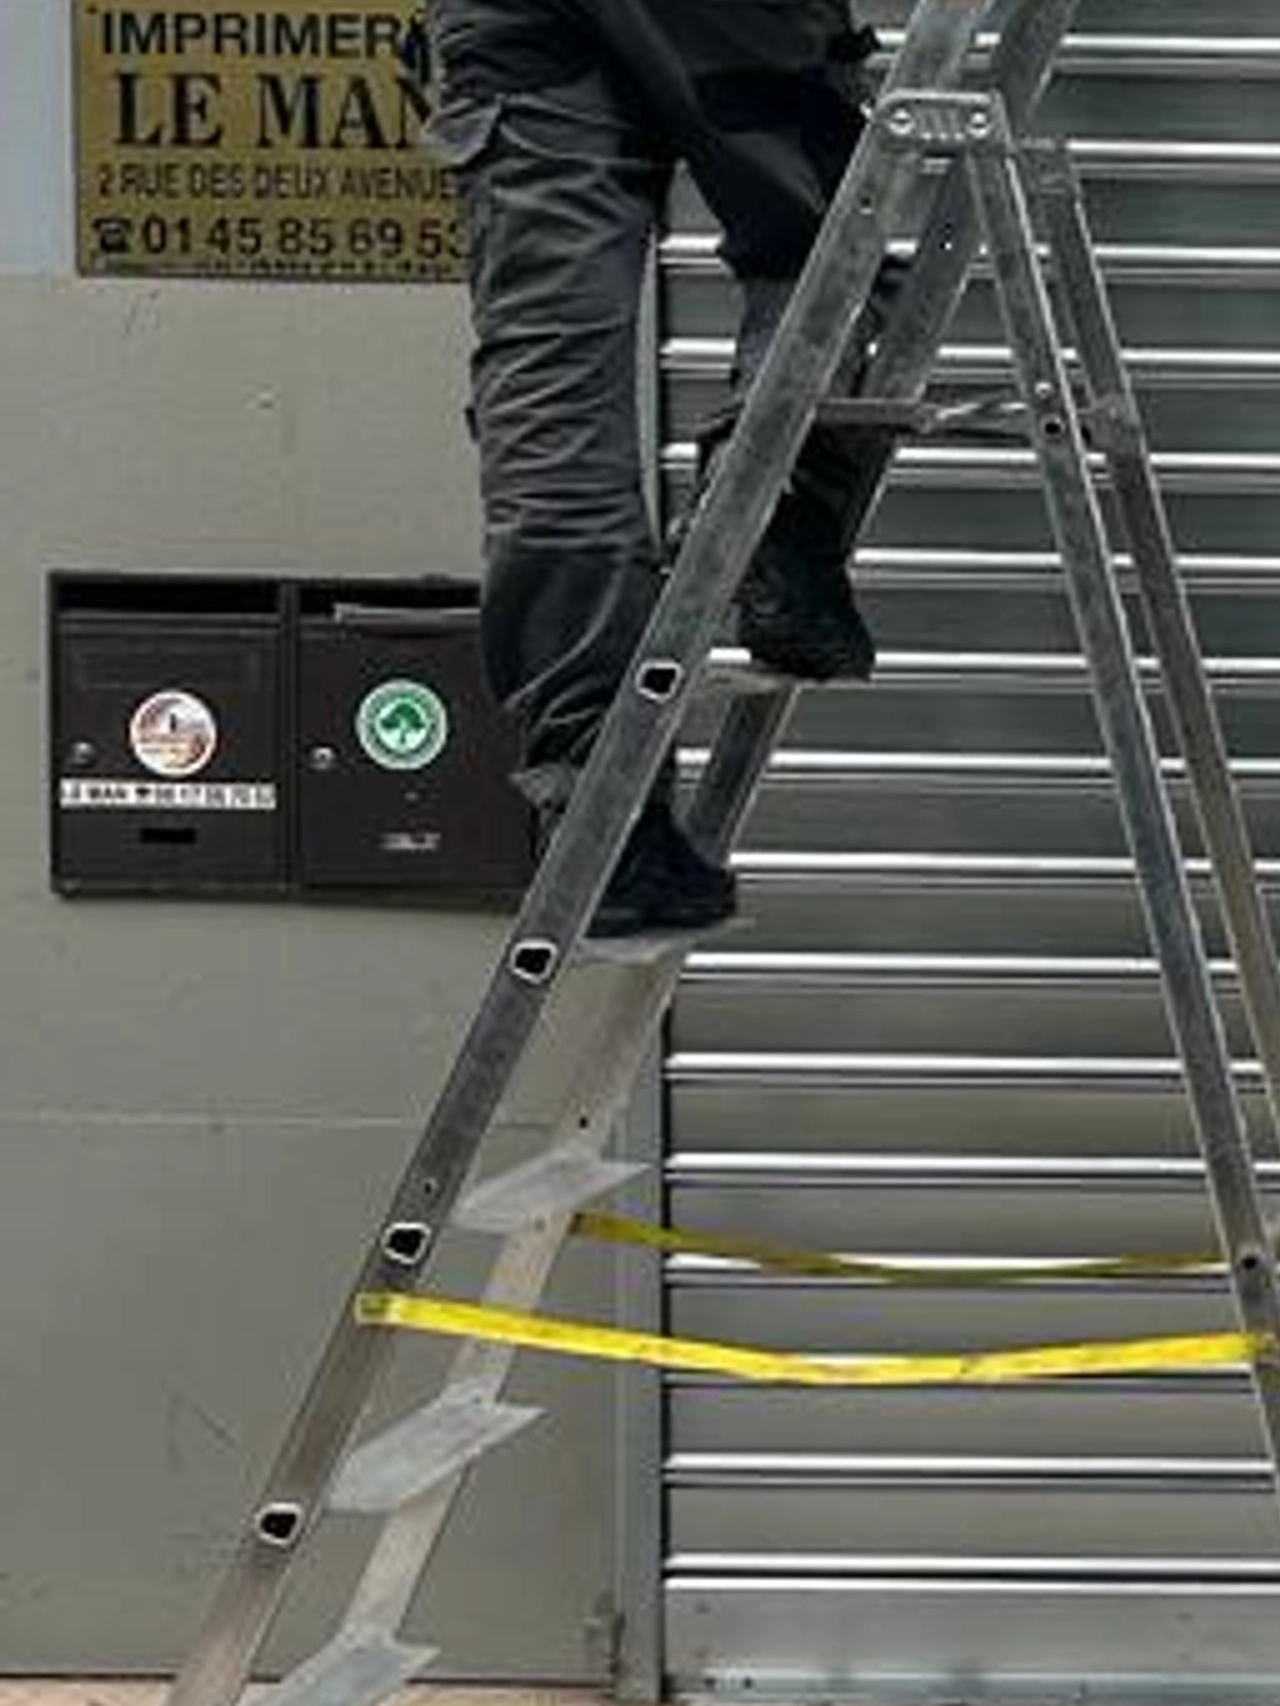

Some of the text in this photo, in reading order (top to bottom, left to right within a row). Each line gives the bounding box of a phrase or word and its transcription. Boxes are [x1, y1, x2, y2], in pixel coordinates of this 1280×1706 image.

[102, 12, 401, 59] IMPRIMER
[113, 72, 434, 150] LE MAN
[98, 163, 113, 196] 2
[119, 163, 181, 198] RUE
[189, 162, 245, 198] DES
[254, 162, 327, 199] DEUX
[142, 215, 192, 255] 01
[206, 216, 263, 255] 45
[278, 216, 334, 255] 85
